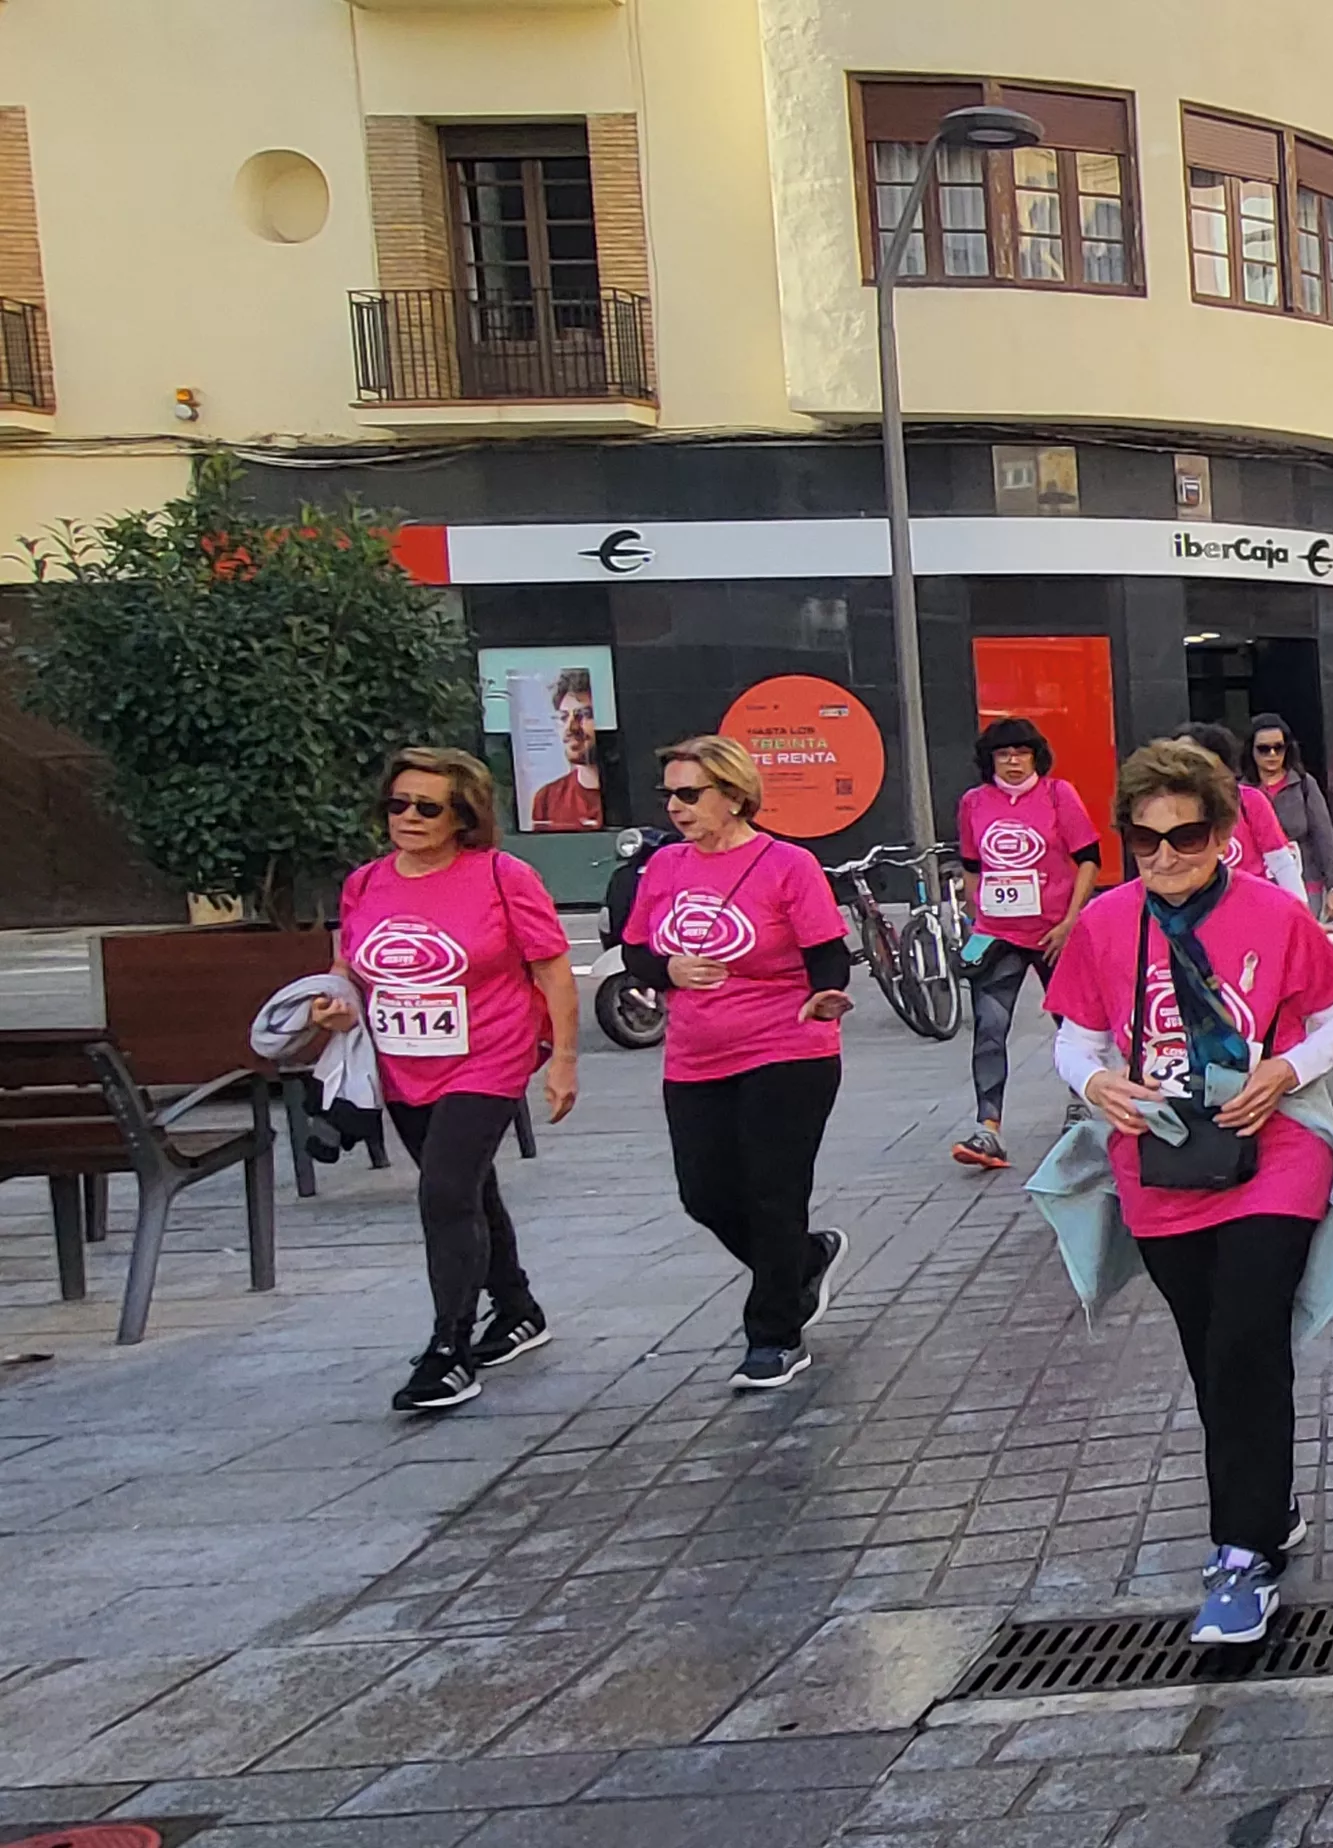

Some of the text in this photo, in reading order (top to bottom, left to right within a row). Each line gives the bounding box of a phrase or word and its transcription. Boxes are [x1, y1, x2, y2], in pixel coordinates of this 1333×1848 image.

[1173, 533, 1289, 569] iberCaja
[748, 726, 816, 735] HASTA LOS
[751, 737, 828, 750] TREINTA
[751, 752, 837, 765] TE RENTA
[994, 887, 1019, 904] 99
[376, 1009, 456, 1036] 3114
